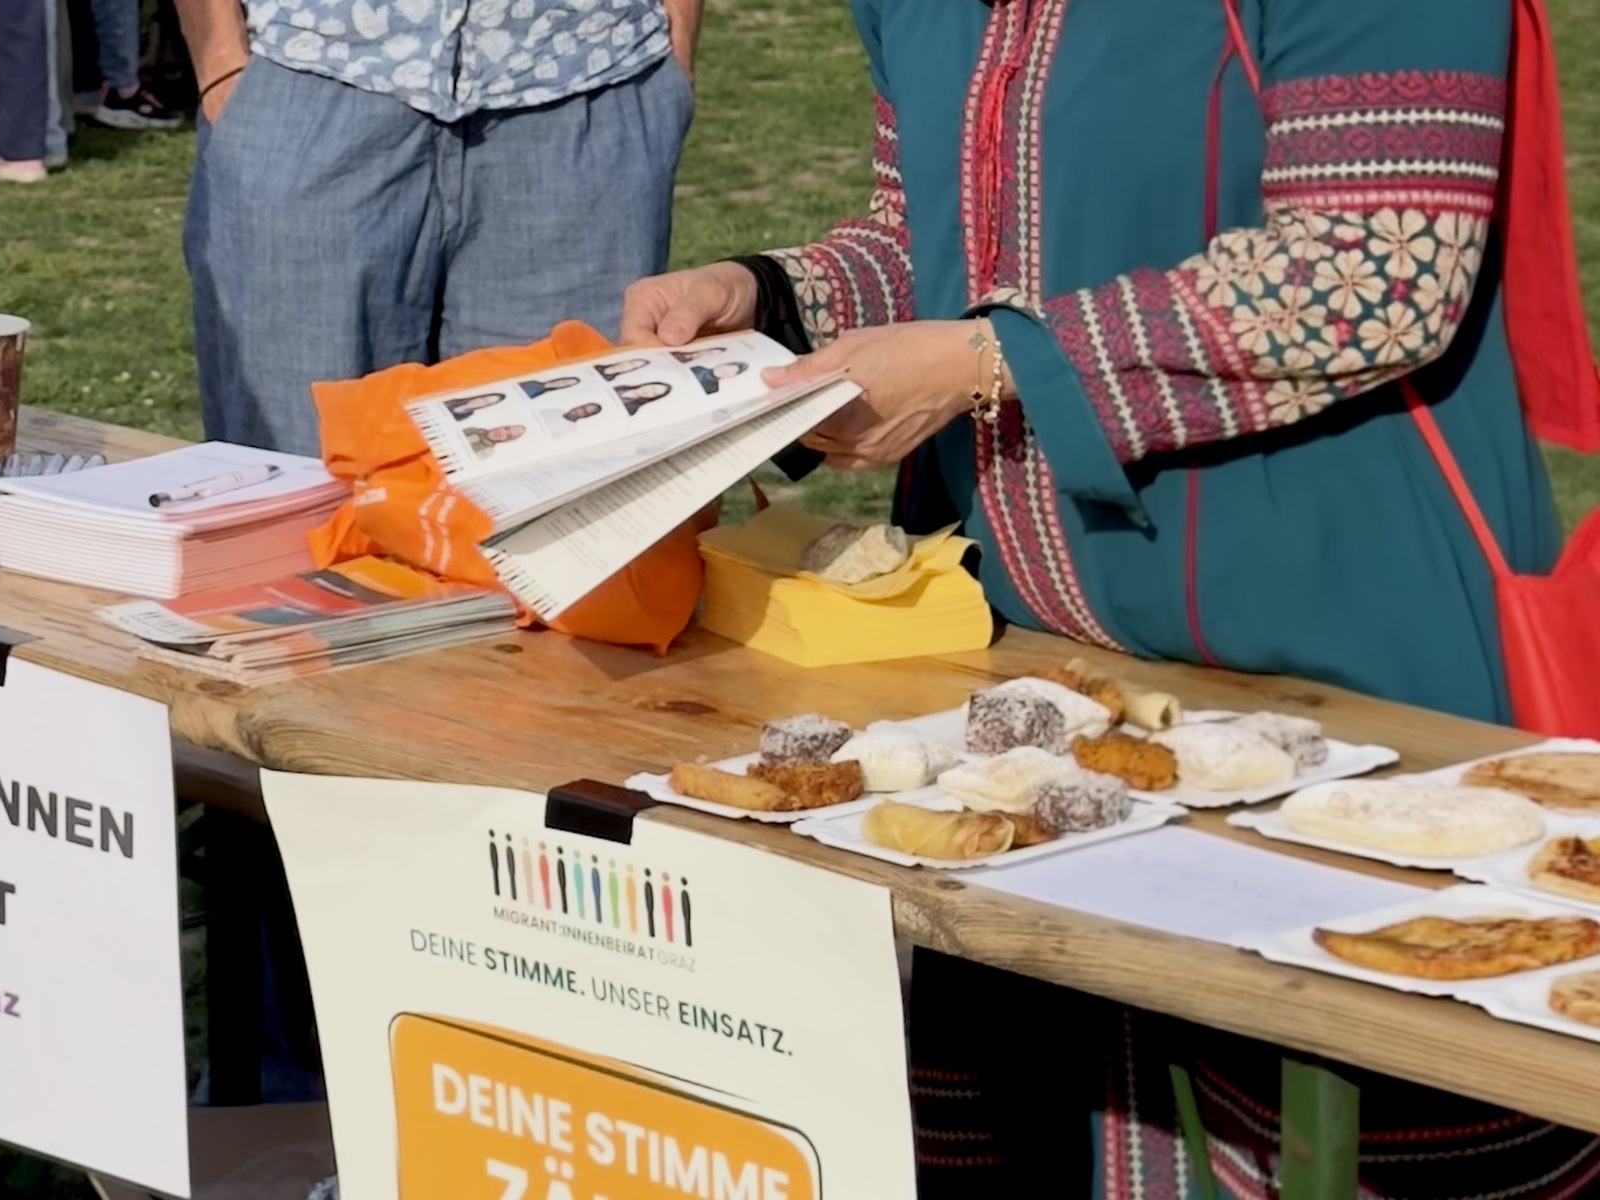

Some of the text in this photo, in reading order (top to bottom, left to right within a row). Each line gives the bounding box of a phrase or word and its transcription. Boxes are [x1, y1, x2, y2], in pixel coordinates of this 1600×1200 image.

[409, 928, 794, 1057] DEINE STIMME. UNSER EINSATZ.
[431, 1062, 791, 1200] DEINE STIMME
